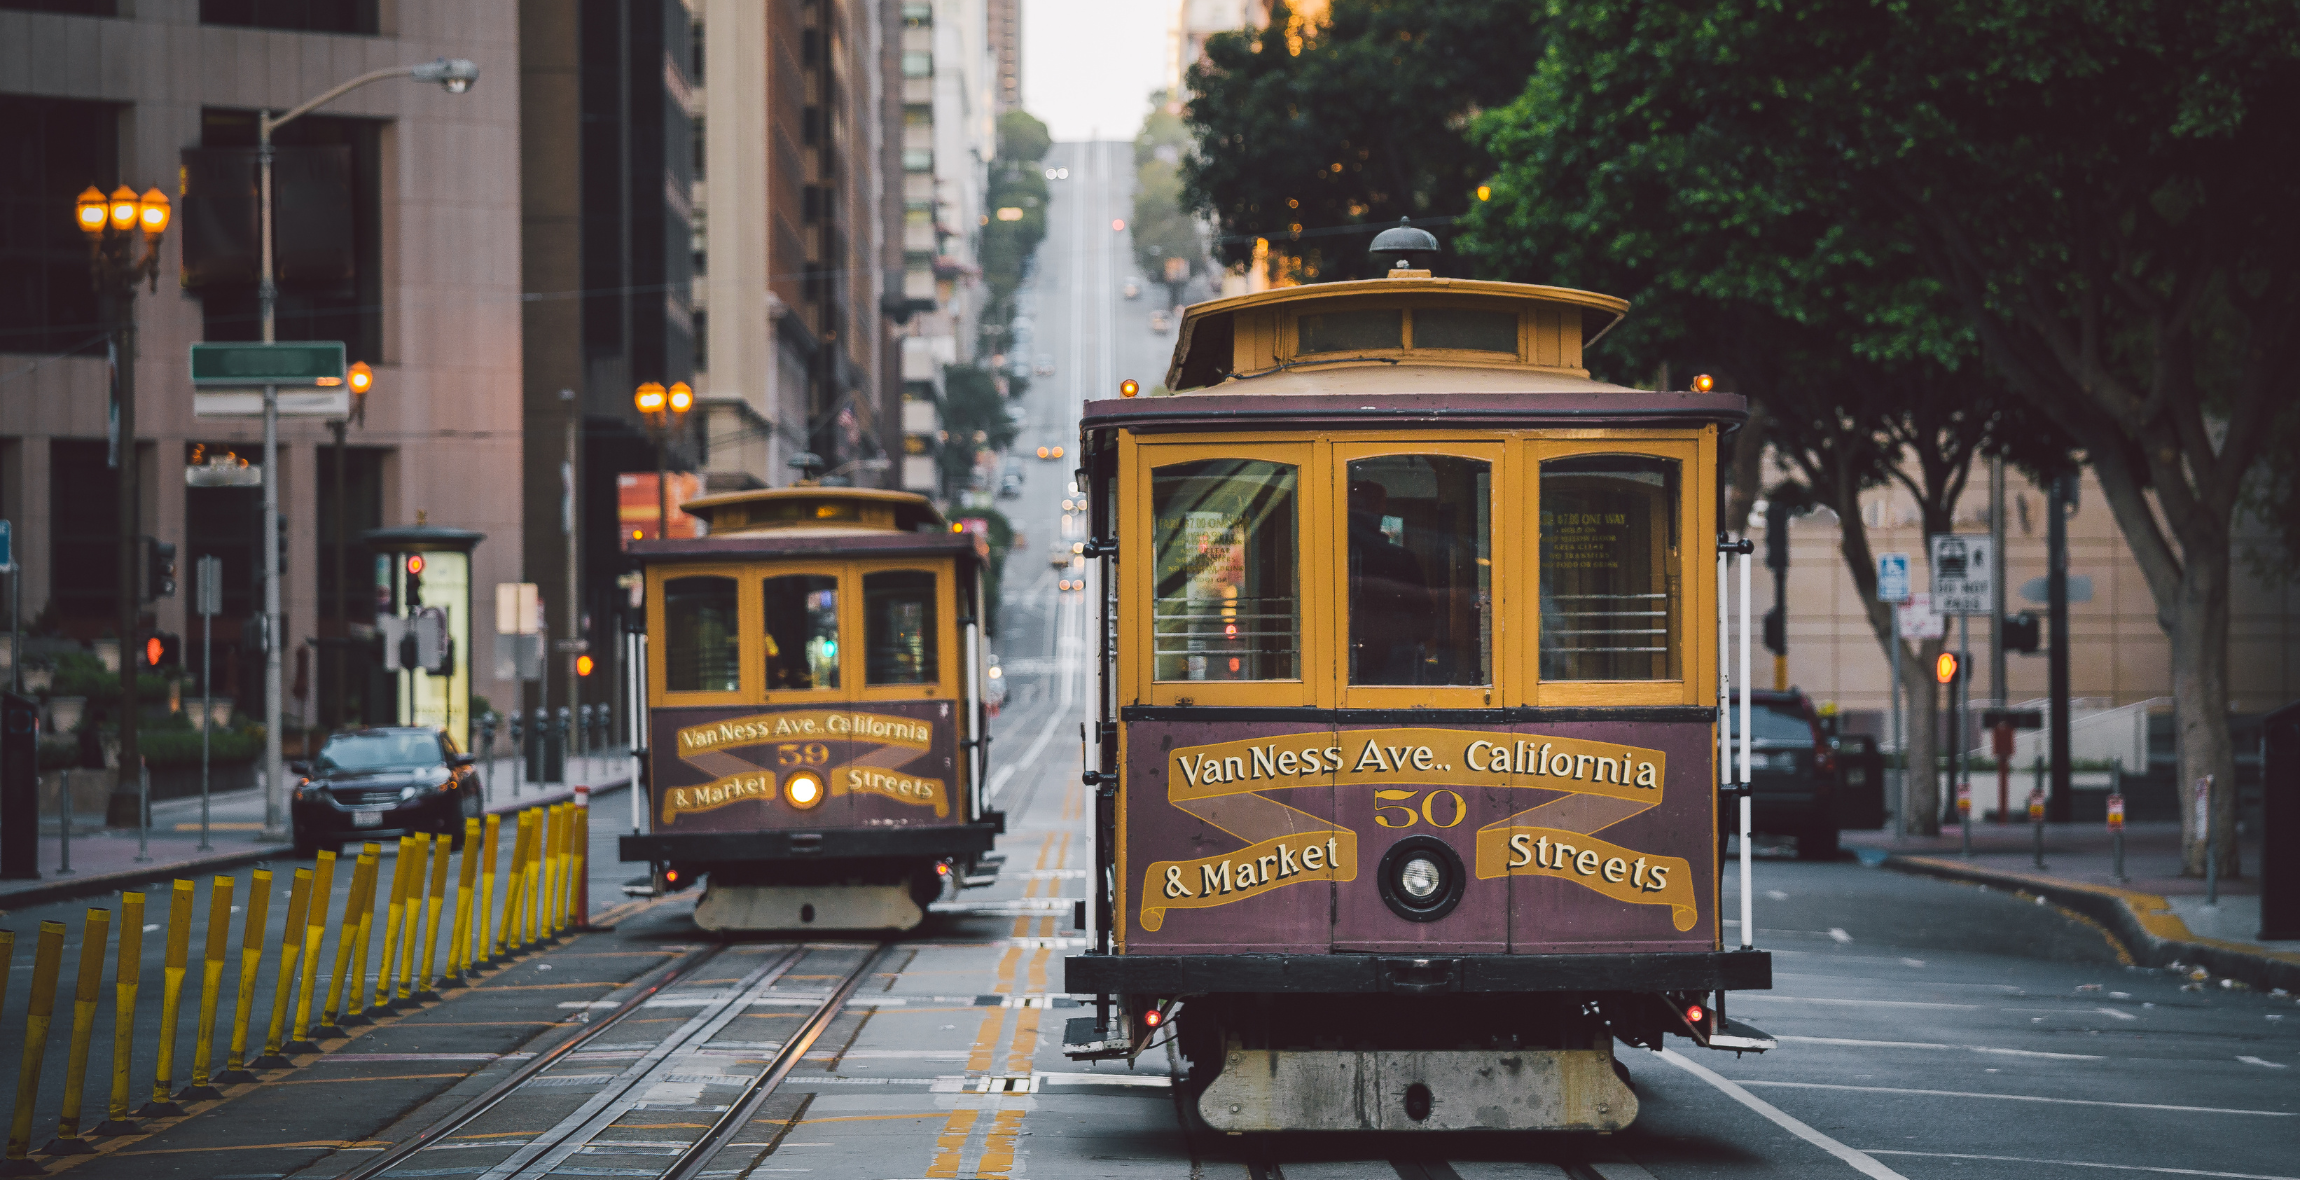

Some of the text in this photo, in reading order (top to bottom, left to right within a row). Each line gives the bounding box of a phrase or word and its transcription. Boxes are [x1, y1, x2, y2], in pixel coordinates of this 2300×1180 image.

[1582, 513, 1601, 525] ONE
[1605, 513, 1626, 525] WAY
[826, 714, 929, 743] California
[778, 743, 829, 766] 59
[1178, 739, 1657, 789] Van Ness Ave., California
[673, 769, 934, 807] & Market Streets
[1374, 789, 1467, 829] 50
[1163, 834, 1670, 899] & Market Streets
